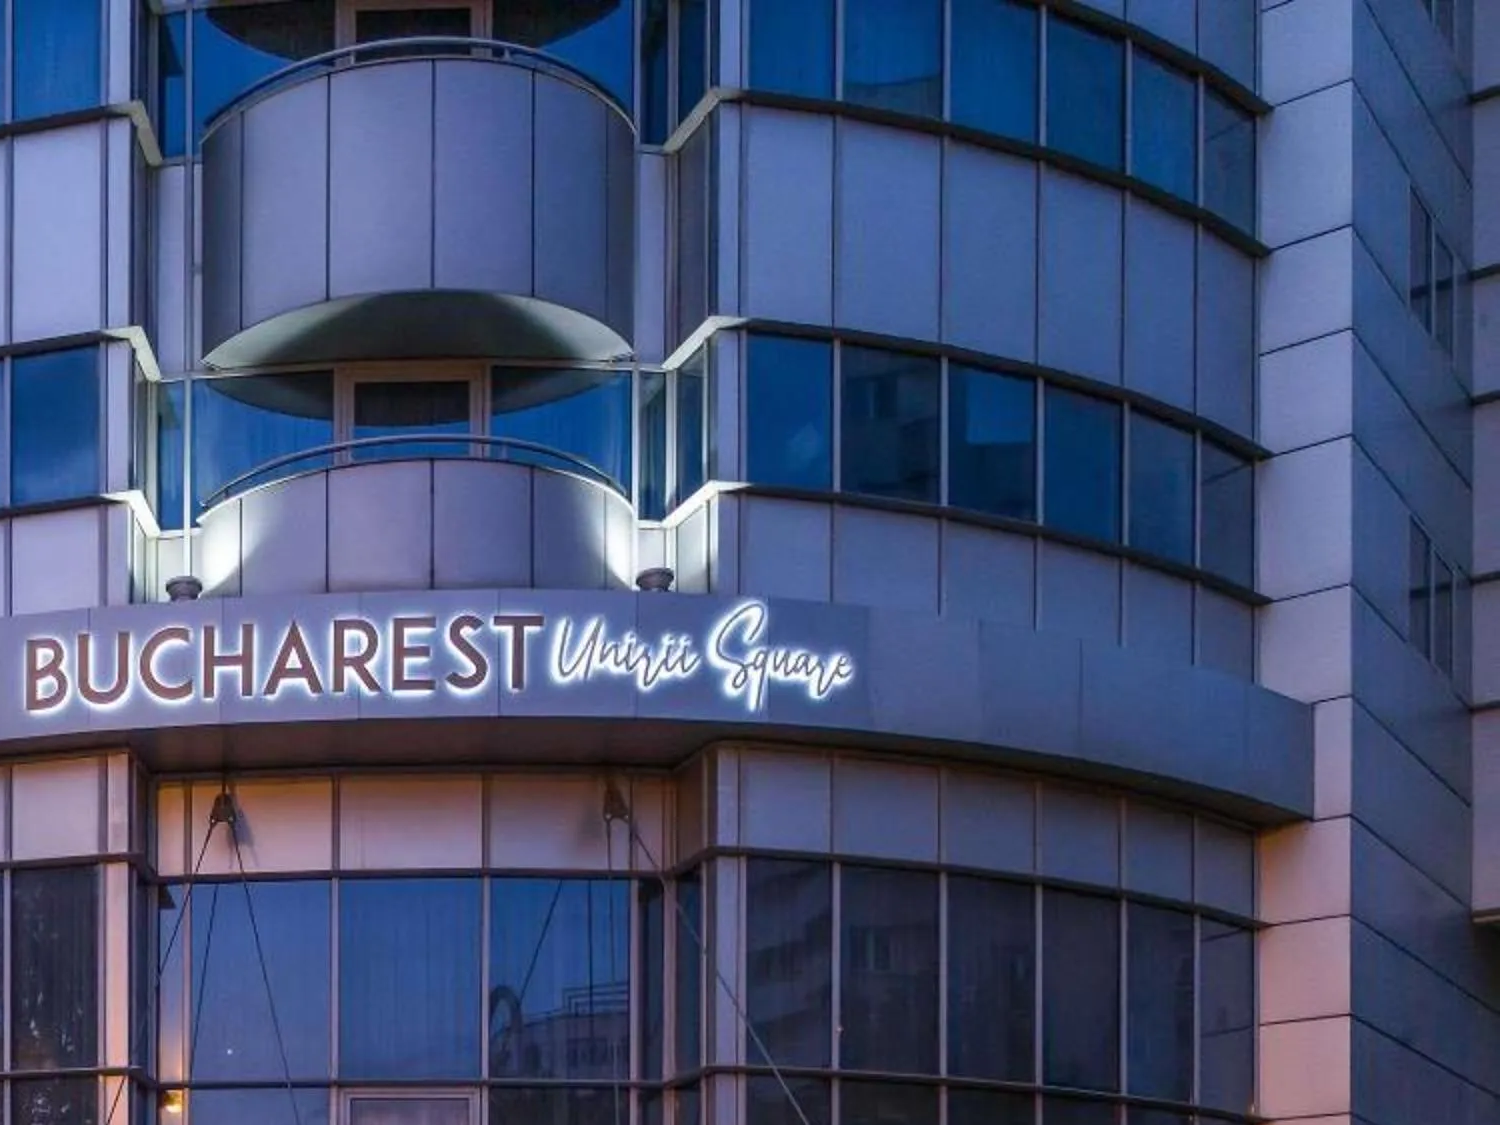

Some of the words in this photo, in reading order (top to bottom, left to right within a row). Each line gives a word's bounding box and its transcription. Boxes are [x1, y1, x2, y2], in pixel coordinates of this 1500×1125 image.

[24, 613, 545, 713] BUCHAREST
[555, 613, 701, 691] Unirii
[709, 600, 853, 710] Square
